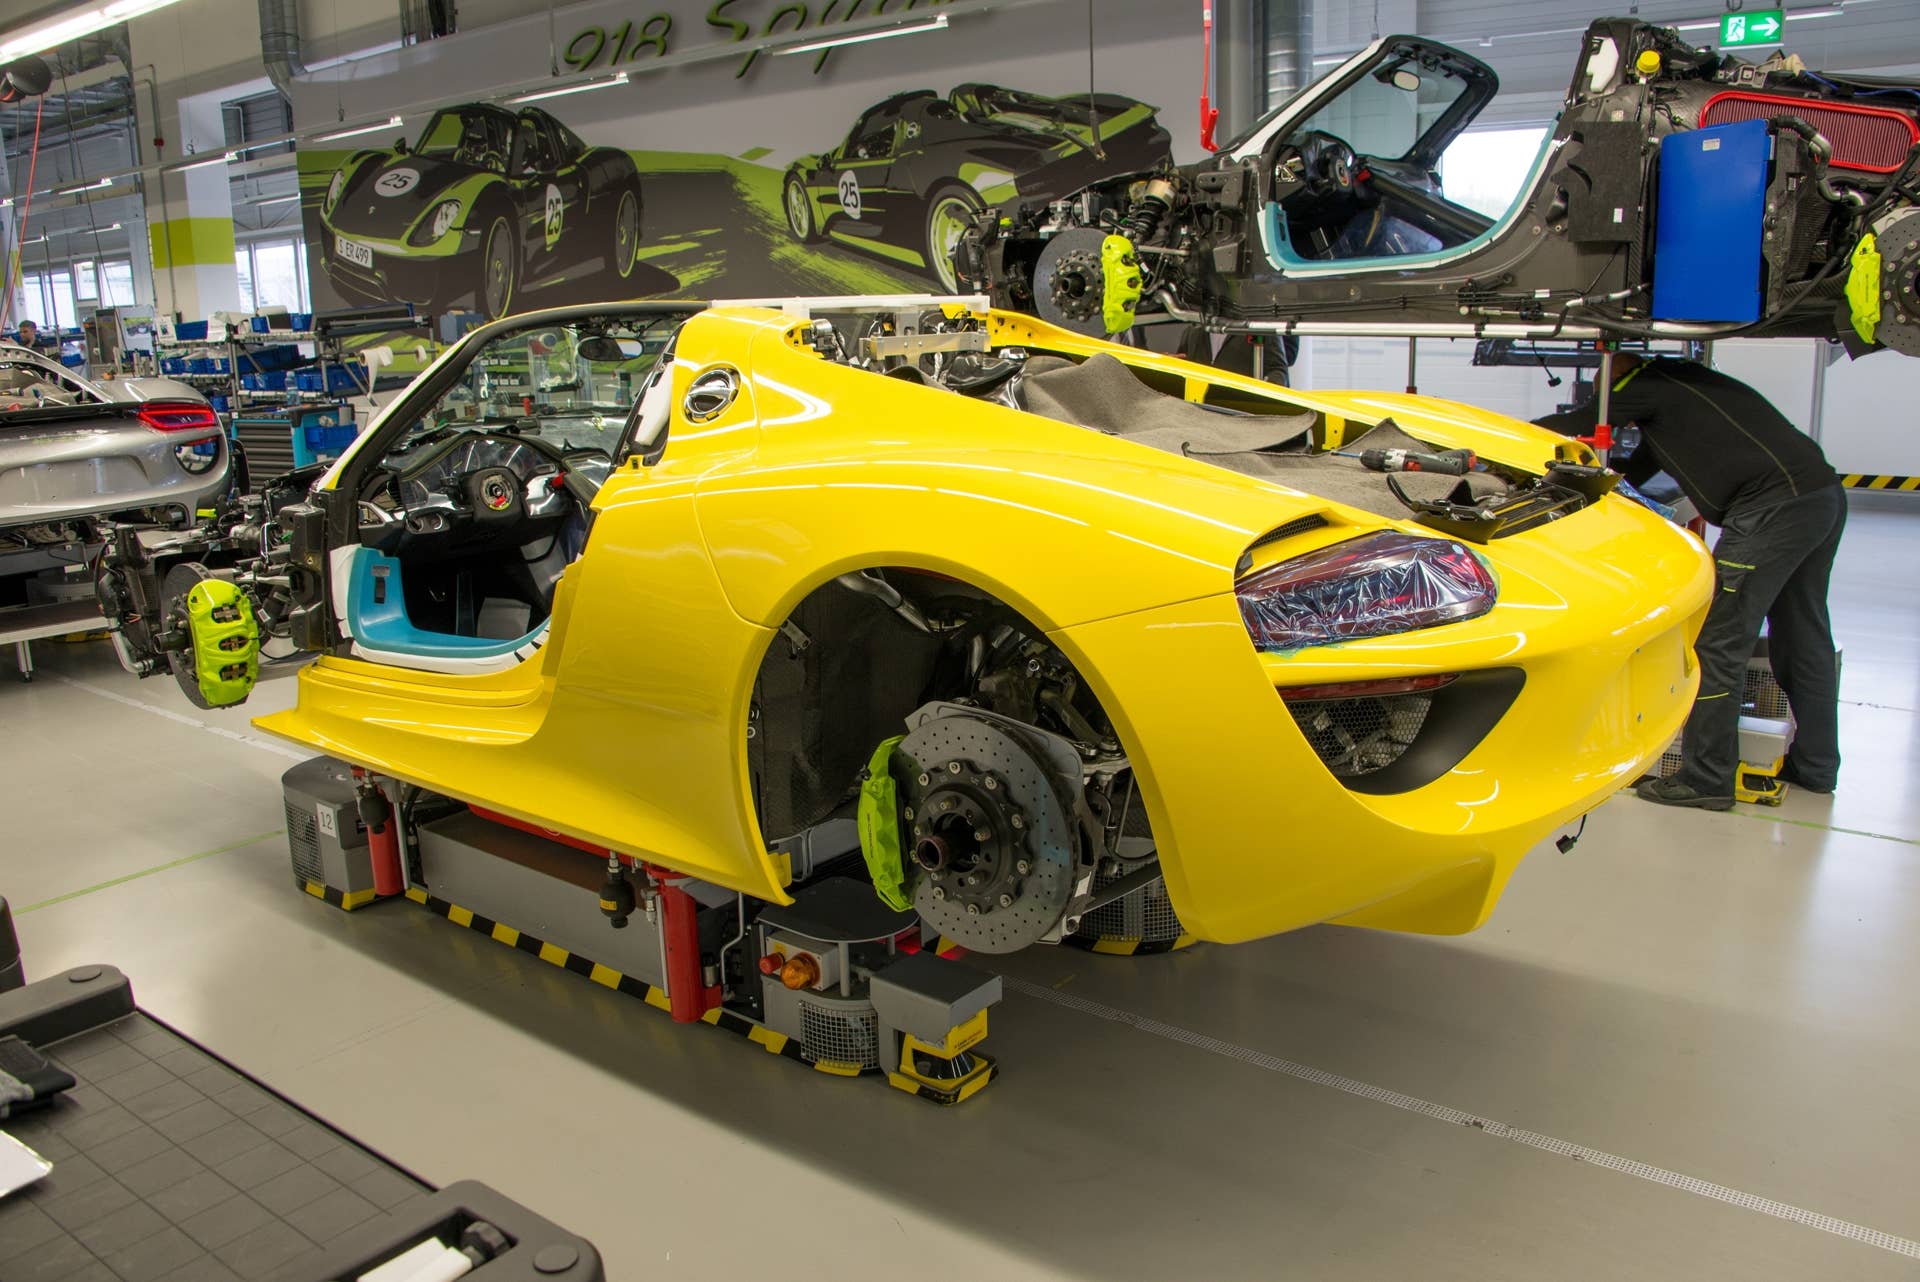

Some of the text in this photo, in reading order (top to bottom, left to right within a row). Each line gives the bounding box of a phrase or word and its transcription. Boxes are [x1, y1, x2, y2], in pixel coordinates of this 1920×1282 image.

[564, 12, 672, 71] 918
[381, 173, 412, 189] 25
[842, 181, 858, 208] 25
[548, 198, 561, 235] 25
[346, 242, 355, 261] ER
[356, 246, 368, 264] 499
[320, 811, 333, 830] 12
